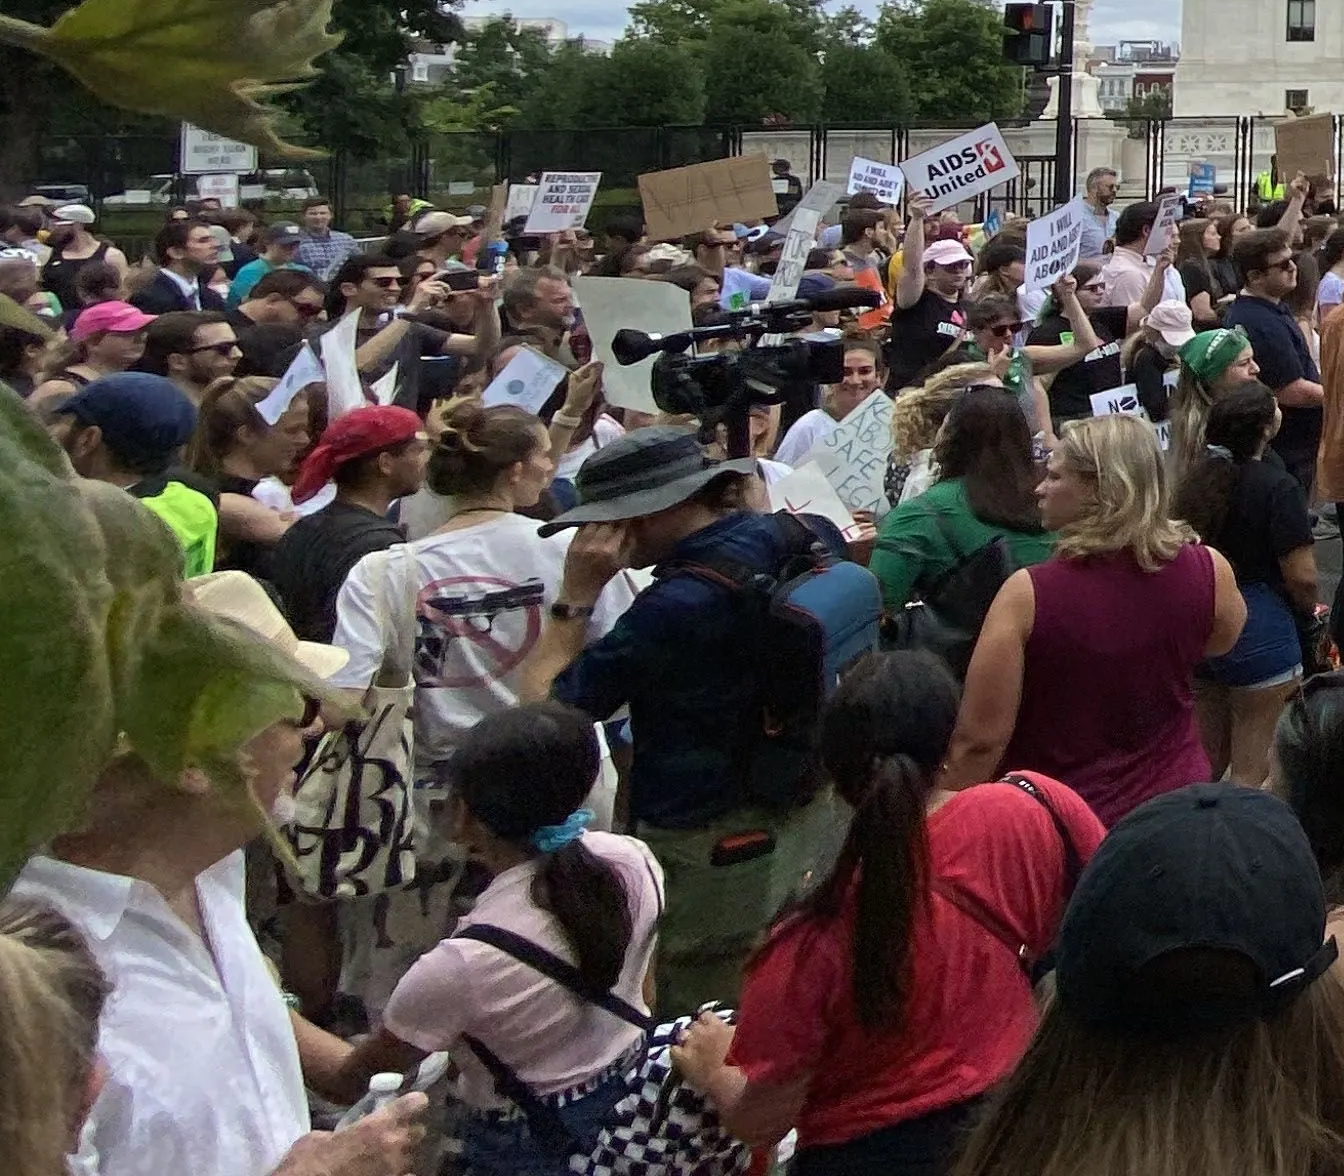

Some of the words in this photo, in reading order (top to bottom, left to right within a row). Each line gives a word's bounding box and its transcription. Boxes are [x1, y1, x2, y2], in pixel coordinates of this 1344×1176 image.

[927, 146, 978, 181] AIDS
[863, 176, 878, 186] AND
[924, 164, 986, 200] United
[1057, 212, 1073, 233] WILL
[1030, 245, 1049, 265] AID
[1050, 235, 1069, 256] AND
[823, 427, 885, 481] SAFE
